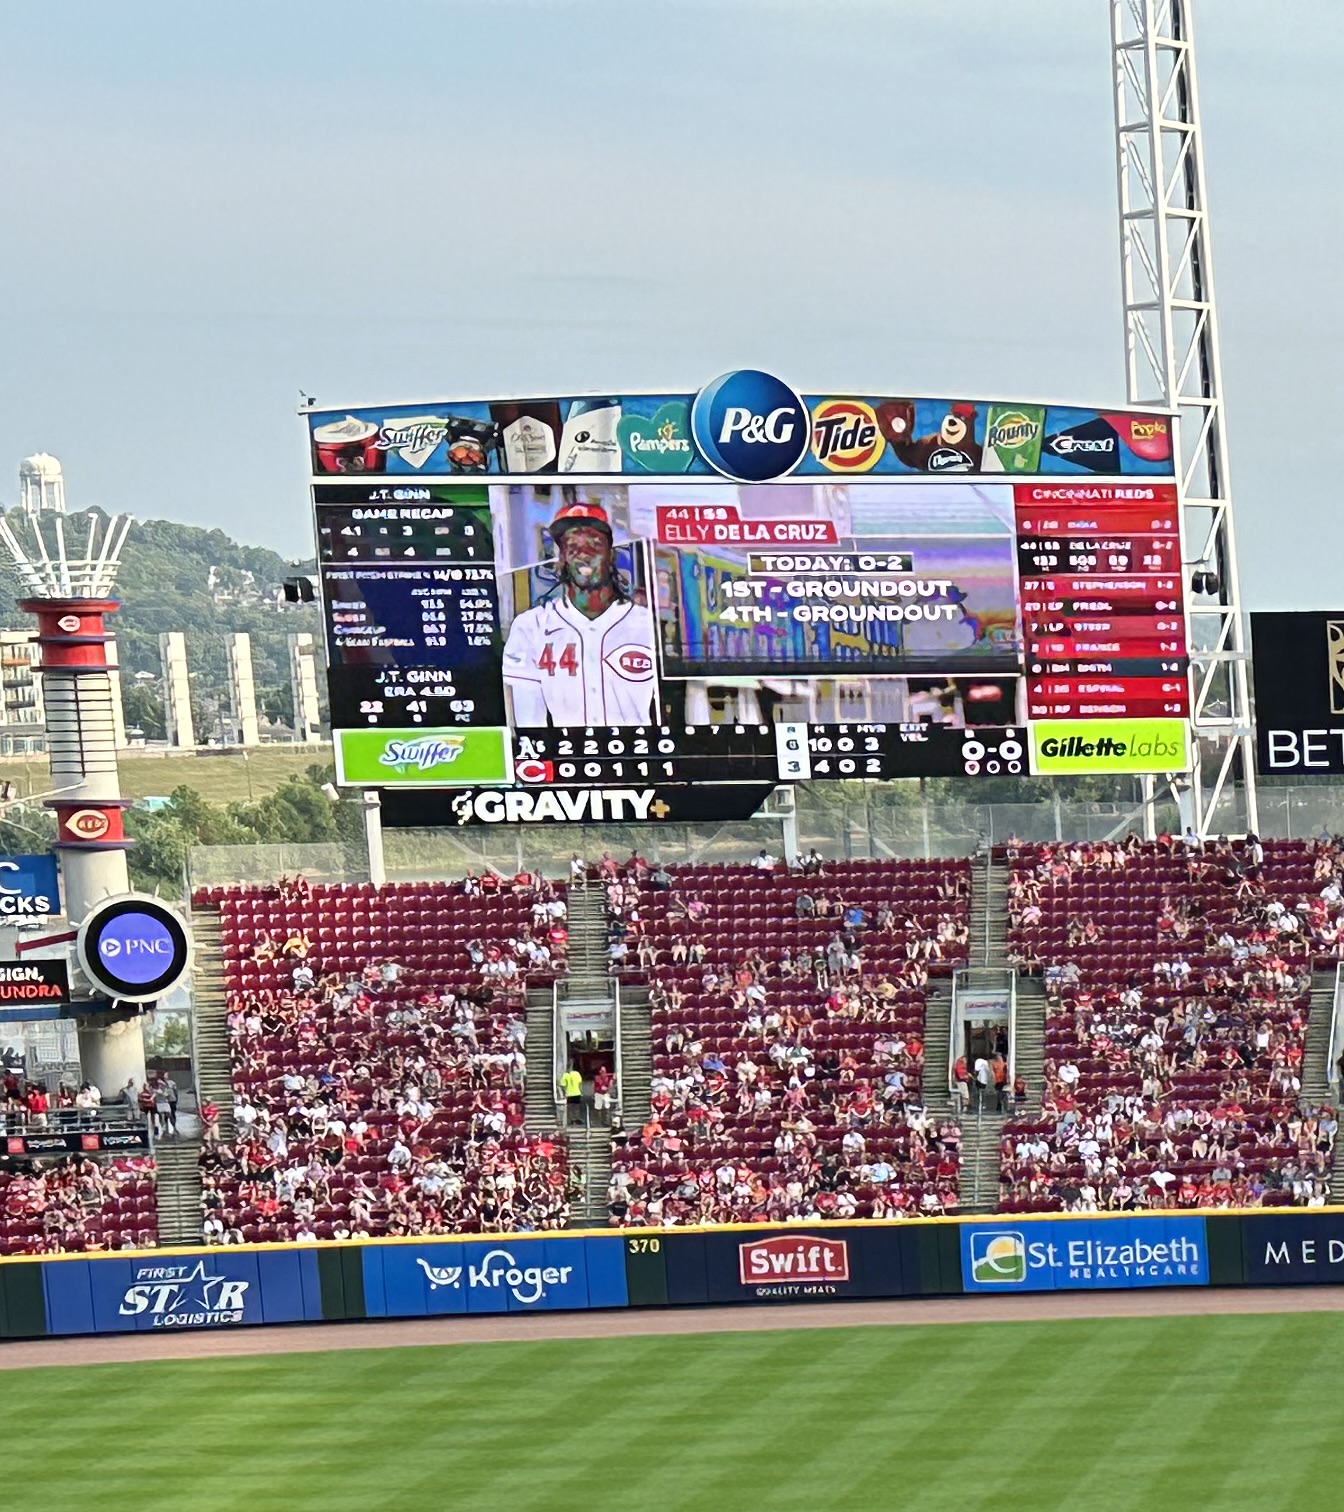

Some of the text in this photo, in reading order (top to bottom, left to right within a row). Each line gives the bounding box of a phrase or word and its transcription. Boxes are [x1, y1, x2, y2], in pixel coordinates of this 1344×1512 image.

[719, 407, 796, 444] P&G
[630, 432, 690, 453] Pampers
[815, 415, 876, 459] Tide
[665, 523, 828, 542] ELLY DE LA CRUZ
[760, 555, 904, 572] TODAY: 0-2
[720, 581, 768, 598] 1ST
[786, 580, 952, 598] GROUNDOUT
[719, 604, 772, 623] 4TH
[793, 604, 958, 623] GROUNDOUT
[538, 642, 579, 677] 44
[375, 670, 452, 684] J.T. GINN
[380, 740, 462, 769] Swiffer
[558, 739, 574, 755] 2
[583, 739, 599, 755] 2
[607, 739, 625, 755] 0
[633, 739, 649, 755] 2
[657, 738, 675, 754] 0
[808, 737, 833, 752] 10
[837, 737, 854, 752] 0
[864, 736, 880, 751] 3
[961, 740, 1023, 761] 0-0
[558, 762, 576, 778] 0
[583, 762, 602, 778] 0
[612, 762, 623, 777] 1
[637, 761, 649, 777] 1
[662, 761, 674, 777] 1
[813, 759, 830, 774] 4
[838, 759, 856, 774] 0
[866, 759, 882, 773] 2
[126, 939, 170, 955] PNC
[628, 1239, 661, 1254] 370
[1028, 1236, 1199, 1269] St. Elizabeth
[136, 1265, 189, 1280] FIRST
[1069, 1264, 1199, 1280] HEALTHCARE
[152, 1309, 244, 1327] LOGISTICS
